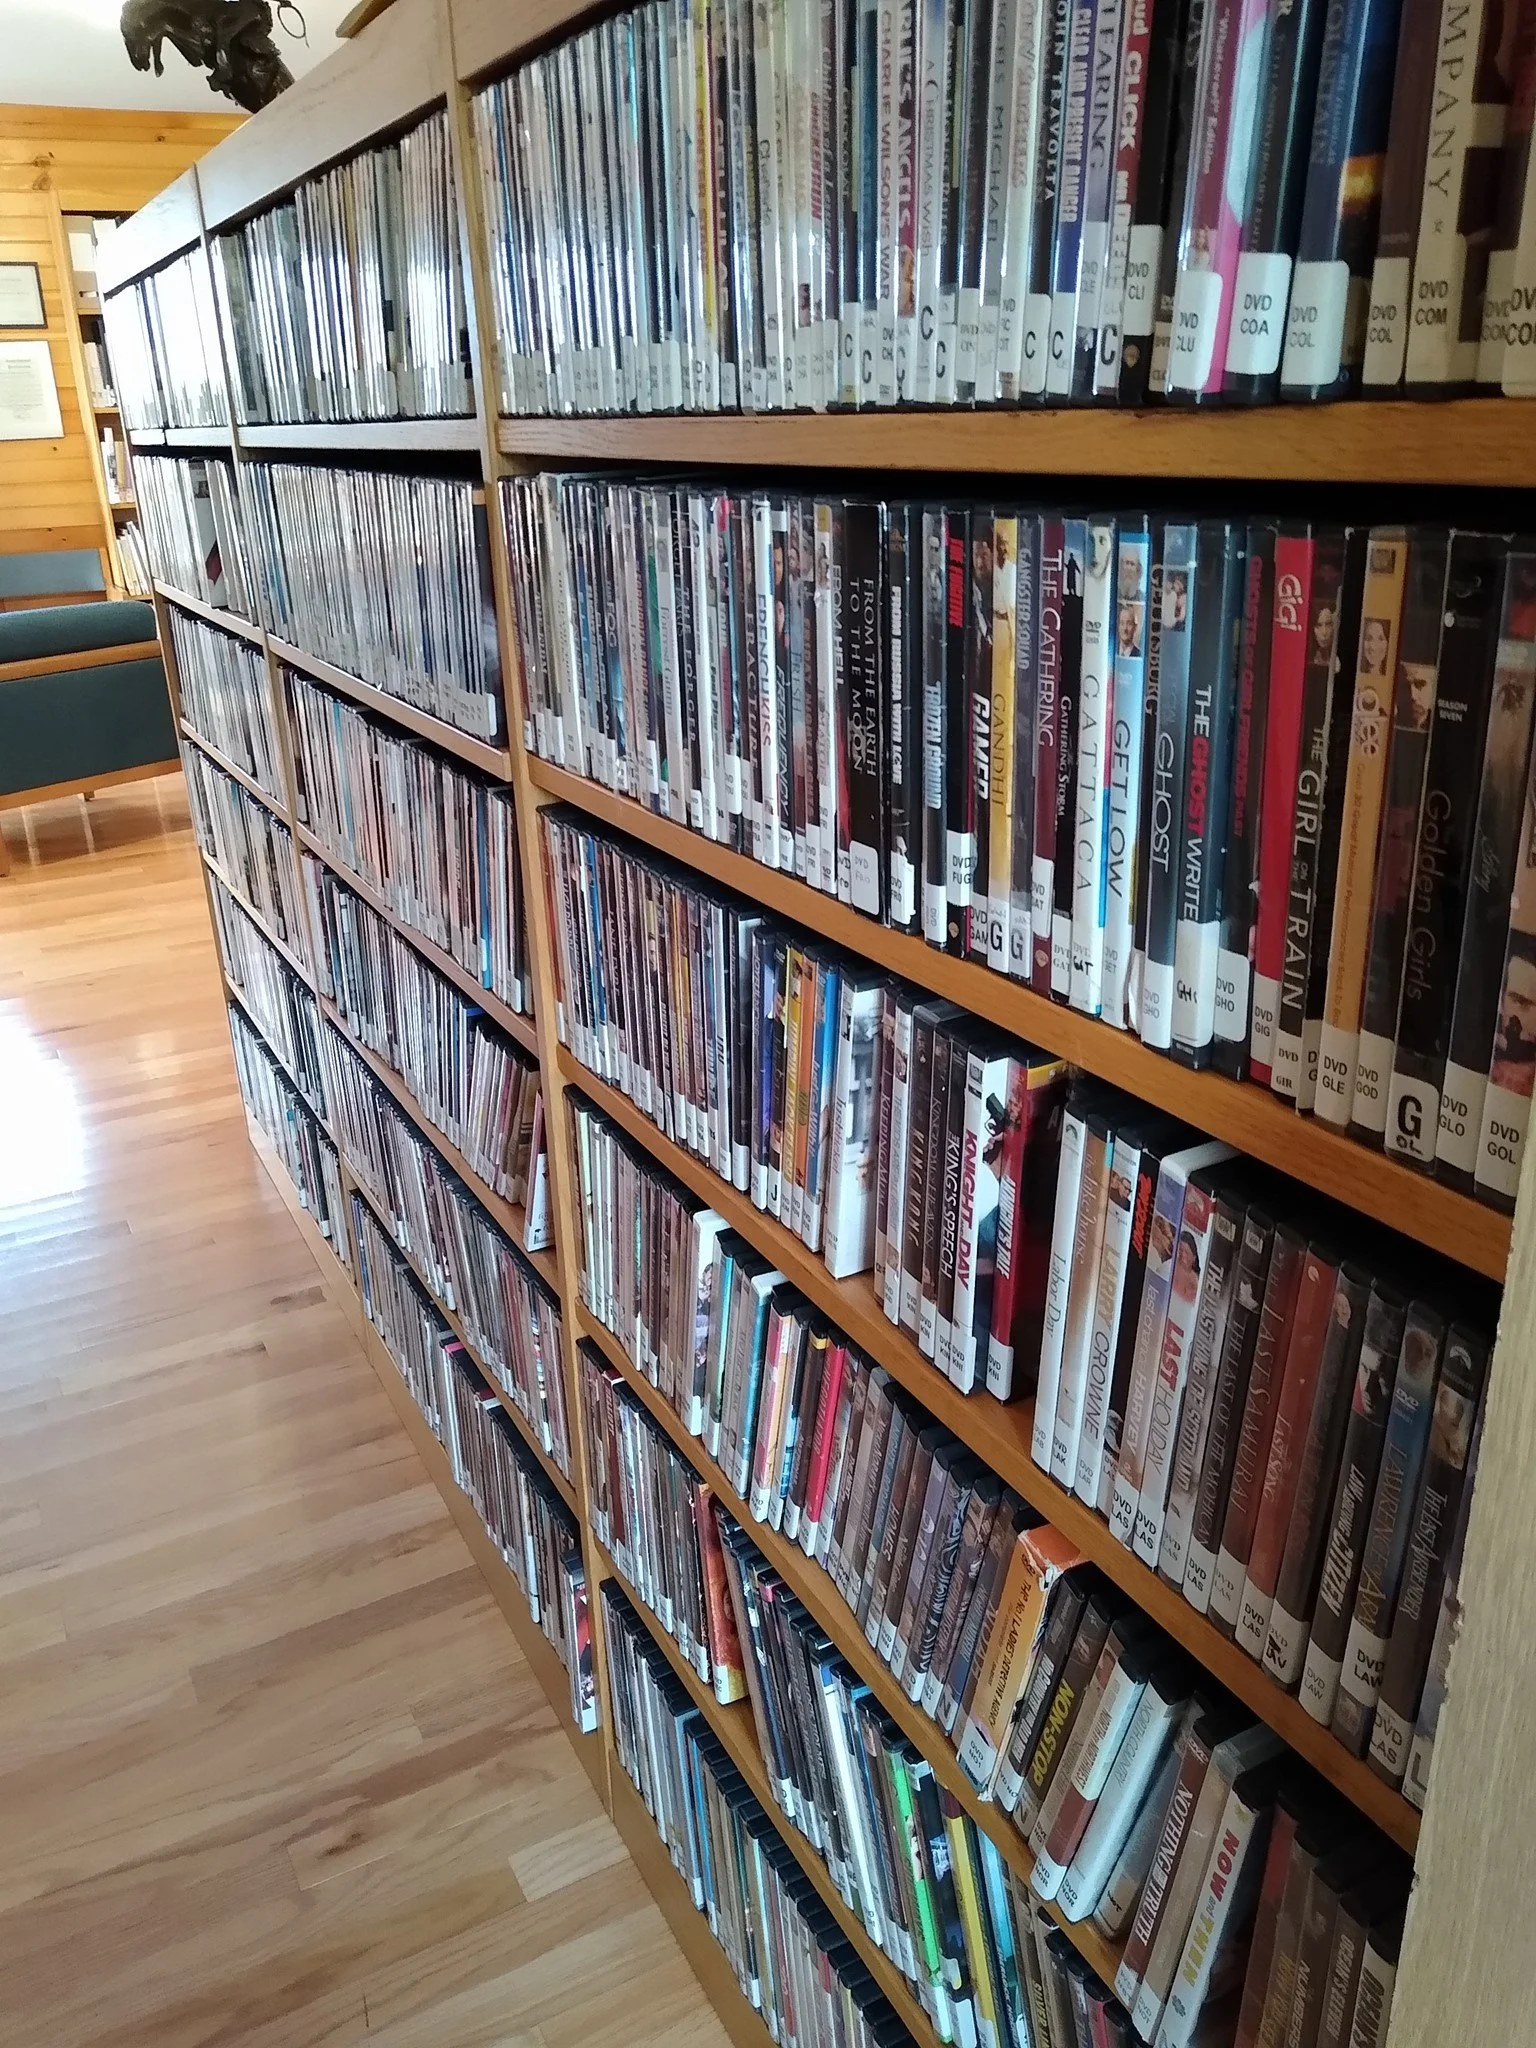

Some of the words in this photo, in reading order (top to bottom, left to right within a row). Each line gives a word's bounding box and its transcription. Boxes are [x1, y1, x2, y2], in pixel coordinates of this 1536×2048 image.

[1121, 51, 1143, 150] CLICK
[1243, 294, 1273, 311] DVD
[1418, 280, 1449, 299] DVD
[1240, 319, 1270, 336] COA
[1371, 305, 1398, 321] DVD
[1415, 308, 1448, 326] COM
[1368, 328, 1393, 344] COL
[1042, 549, 1063, 600] THE
[864, 579, 875, 645] FROM
[1038, 606, 1061, 748] GATHERING
[1193, 684, 1212, 738] THE
[864, 697, 876, 777] EARTH
[993, 693, 1007, 806] GANDHI
[1152, 732, 1175, 874] GHOST
[1187, 736, 1211, 839] GHOST
[1410, 789, 1452, 924] Golden
[1183, 837, 1203, 923] WRITE
[990, 920, 1003, 953] G
[1281, 886, 1311, 1011] TRAIN
[1403, 925, 1437, 1000] Girls
[1254, 1005, 1273, 1023] DVD
[1254, 1020, 1271, 1037] GIG
[1278, 1047, 1299, 1063] DVD
[1323, 1055, 1349, 1076] DVD
[1275, 1075, 1294, 1090] GIR
[1321, 1074, 1346, 1096] GLE
[1355, 1081, 1379, 1101] GOD
[1356, 1064, 1380, 1083] DVD
[1398, 1093, 1423, 1140] G
[1440, 1093, 1468, 1118] DVD
[1438, 1116, 1467, 1138] GLO
[1489, 1120, 1520, 1144] DVD
[1486, 1142, 1518, 1166] GOL
[960, 1127, 978, 1230] KNIGHT
[908, 1184, 923, 1248] KONG
[940, 1206, 956, 1279] SPEECH
[957, 1241, 972, 1292] DAY
[1049, 1252, 1066, 1297] Labor
[1044, 1302, 1061, 1338] Day
[1160, 1318, 1185, 1392] LAST
[1084, 1331, 1110, 1441] CROWNE
[1147, 1384, 1175, 1476] HOLIDAY
[1230, 1387, 1271, 1514] SAMURAI
[1110, 1506, 1130, 1530] LAS
[1112, 1490, 1133, 1516] DVD
[1197, 1465, 1221, 1546] MOHICAN
[1133, 1524, 1155, 1550] LAS
[1134, 1508, 1158, 1535] DVD
[1186, 1569, 1206, 1592] LAS
[1188, 1557, 1208, 1581] DVD
[1321, 1526, 1354, 1618] CITIZEN
[1241, 1614, 1263, 1640] LAS
[1243, 1601, 1266, 1626] DVD
[1352, 1663, 1384, 1691] LAW
[1356, 1647, 1385, 1673] DVD
[1034, 1678, 1076, 1787] NON-STOP
[1373, 1711, 1404, 1748] DVD
[1157, 1779, 1195, 1875] NOTHING
[1209, 1827, 1241, 1903] NOW
[1063, 1877, 1079, 1900] DVD
[1134, 1880, 1165, 1947] TRUTH
[1182, 1911, 1215, 1988] THEN
